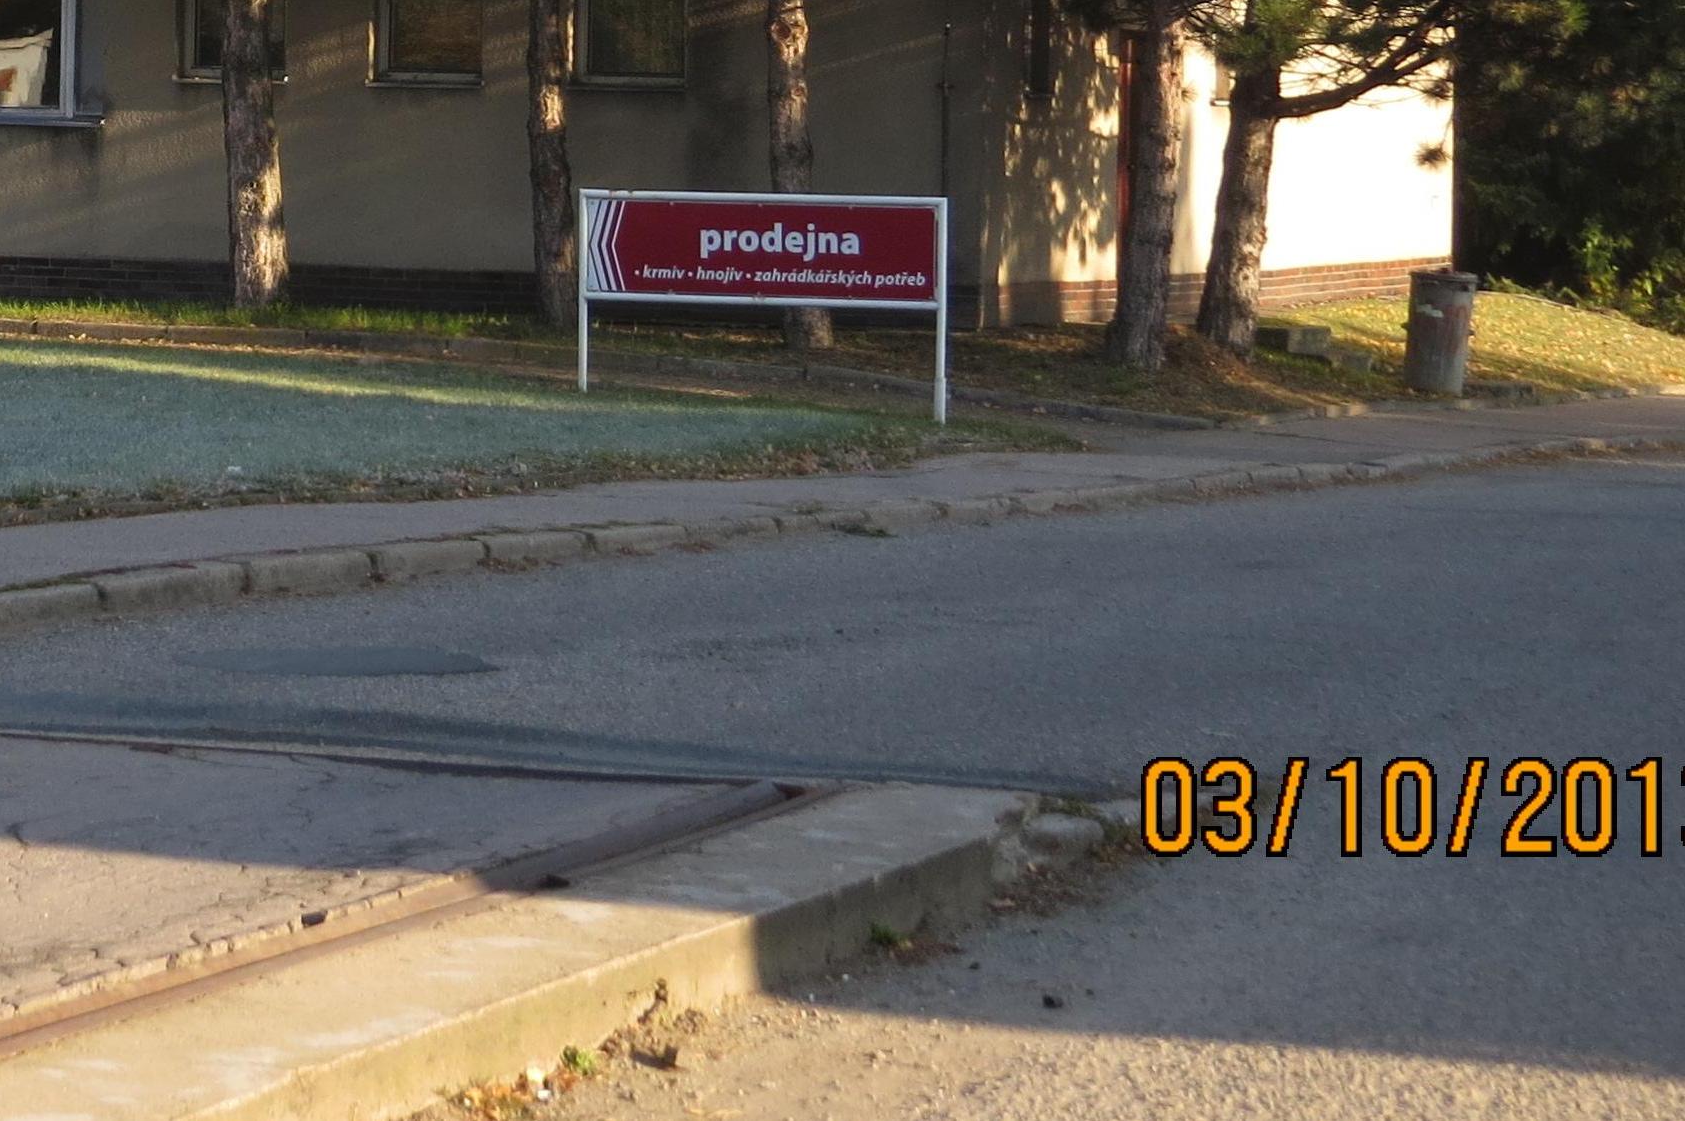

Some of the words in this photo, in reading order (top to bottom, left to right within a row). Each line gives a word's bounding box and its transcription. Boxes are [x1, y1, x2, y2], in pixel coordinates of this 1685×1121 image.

[700, 222, 860, 261] prodejna
[642, 264, 685, 280] krmiv
[696, 266, 744, 283] hnojiv
[754, 267, 872, 287] zahrádkářských
[874, 270, 926, 288] potřeb
